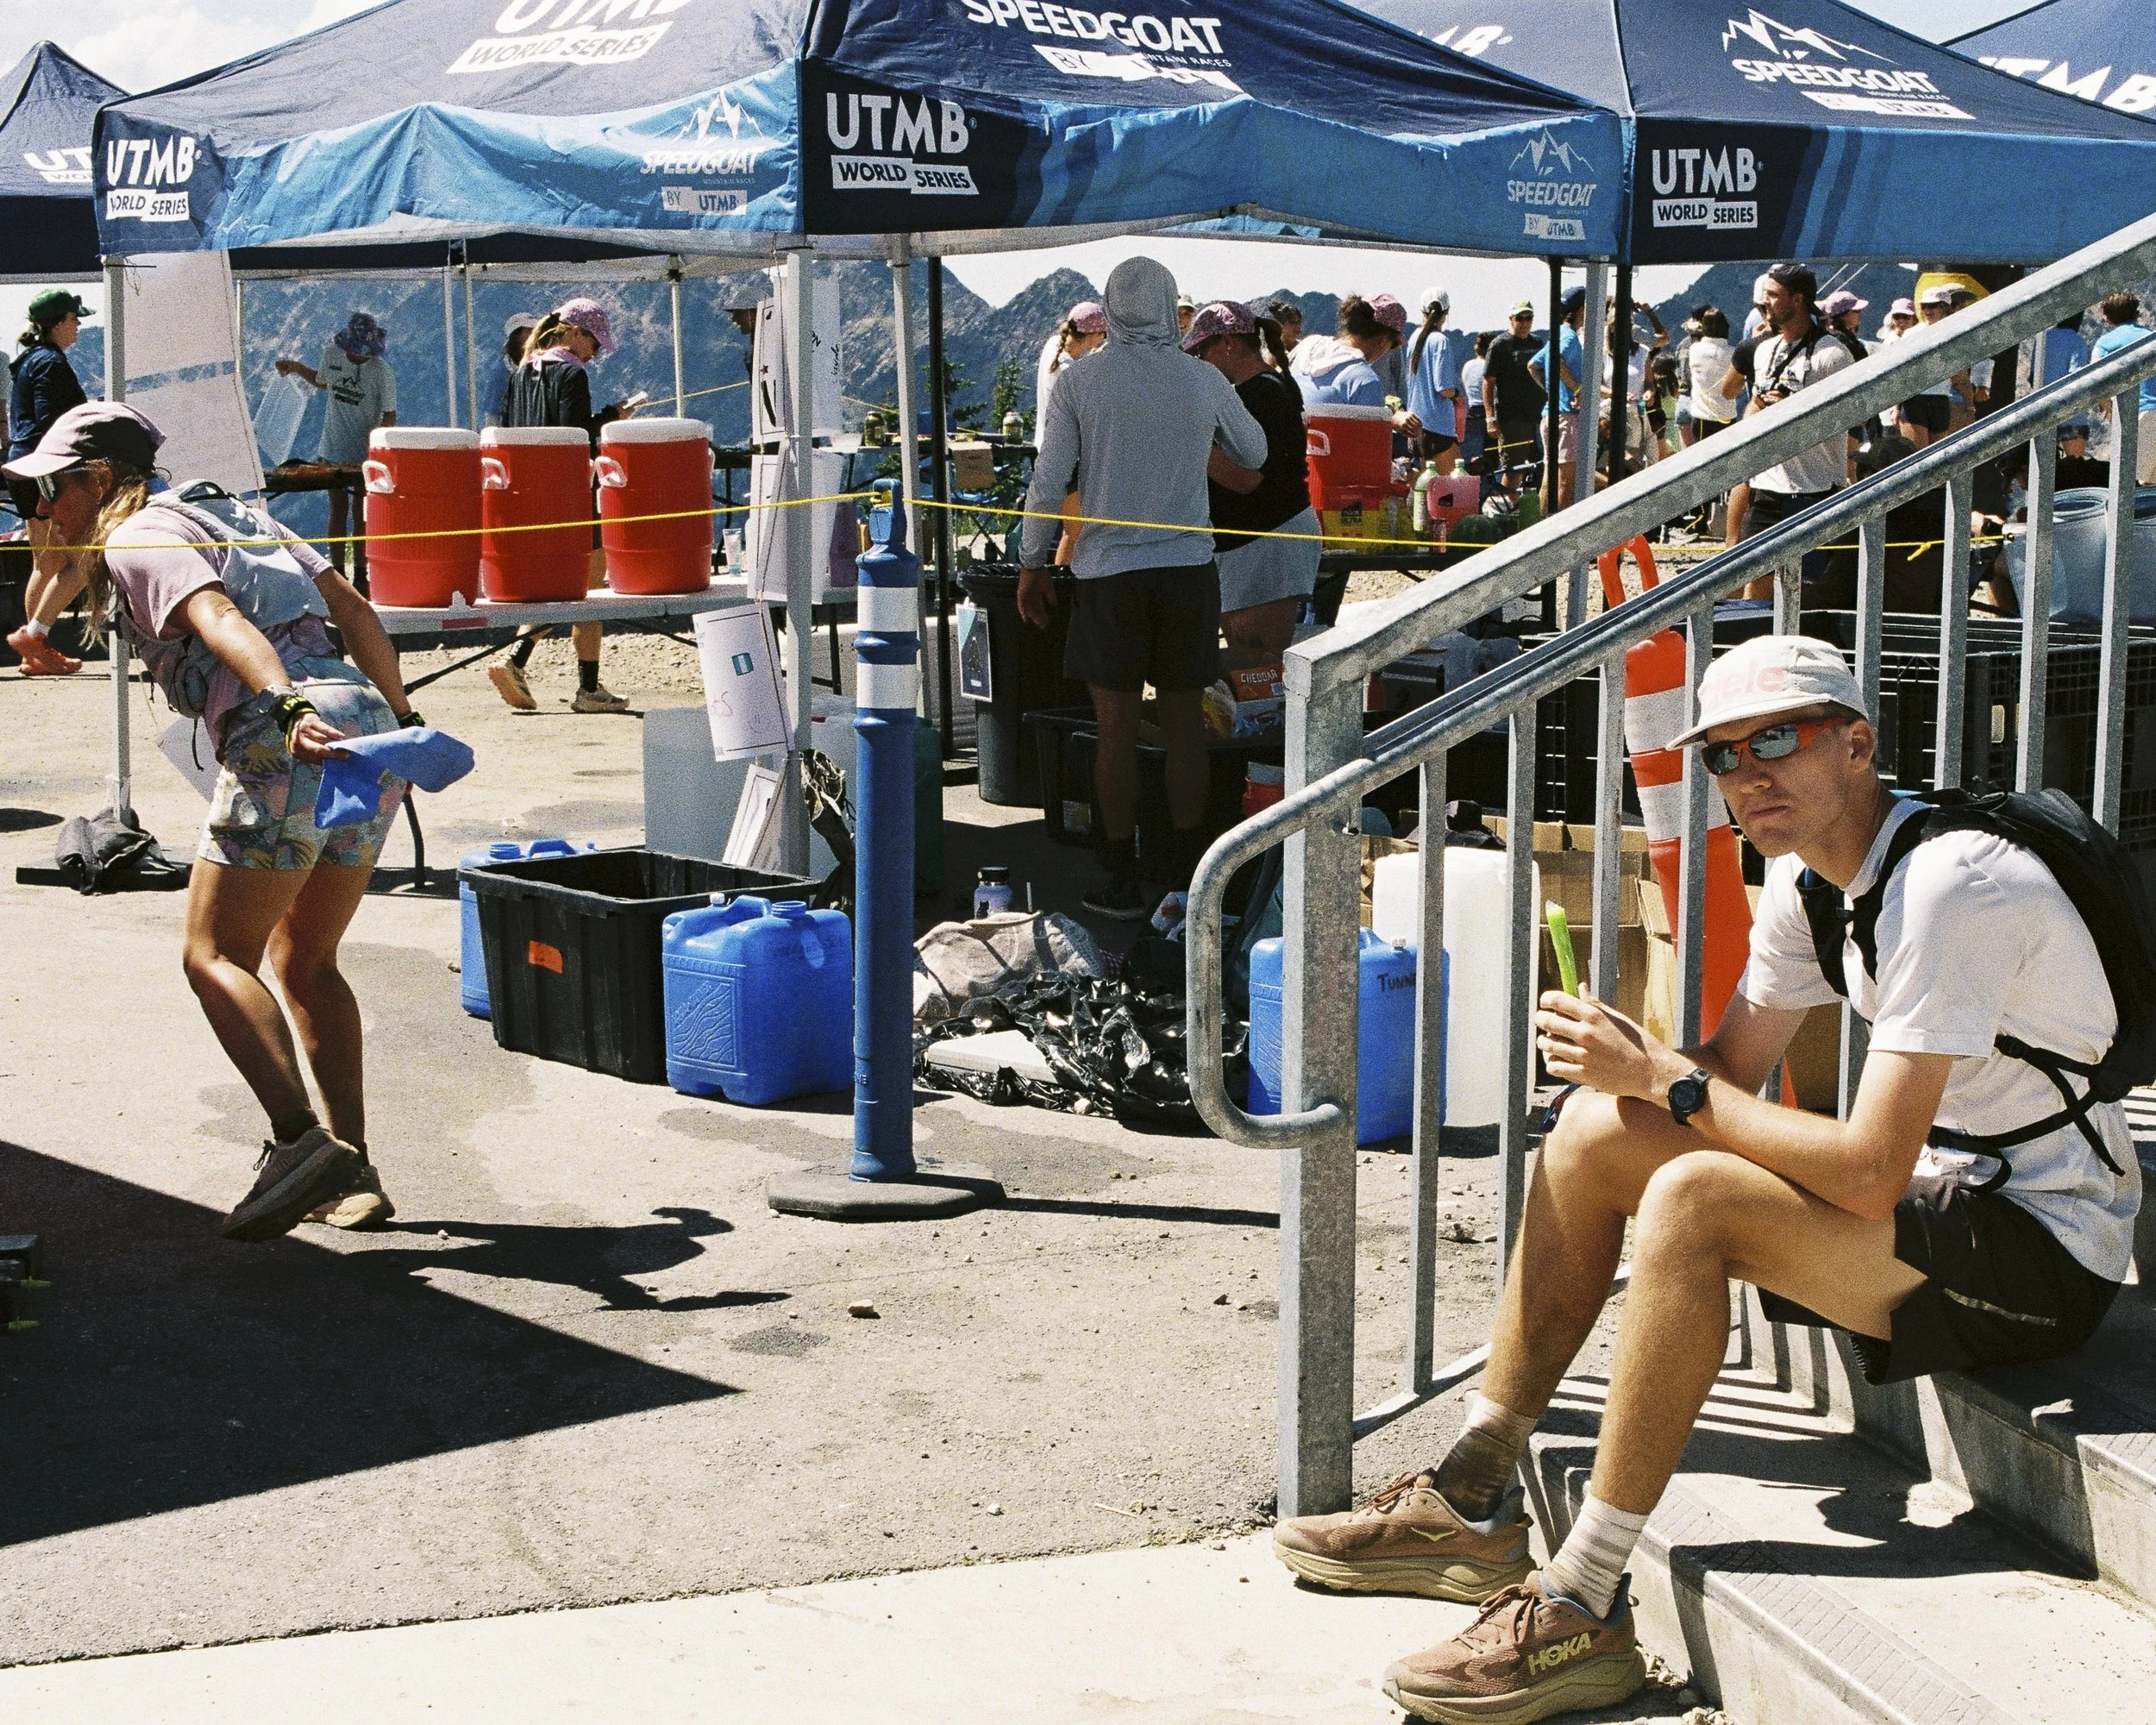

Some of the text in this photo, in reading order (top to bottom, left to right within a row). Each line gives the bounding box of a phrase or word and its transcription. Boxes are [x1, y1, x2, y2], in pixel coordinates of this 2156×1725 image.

[960, 0, 1224, 54] SPEEDGOAT
[467, 32, 657, 65] WORLD SERIES
[1050, 52, 1091, 69] BY
[1190, 57, 1232, 67] RACES
[1732, 59, 1940, 93] SPEEDGOAT
[826, 92, 969, 155] UTMB
[107, 135, 195, 186] UTMB
[640, 147, 764, 174] SPEEDGOAT
[1652, 145, 1757, 195] UTMB
[837, 161, 971, 189] WORLD SERIES
[149, 198, 186, 216] SERIES
[666, 190, 737, 211] BY UTMB
[1507, 179, 1597, 207] SPEEDGOAT
[1528, 217, 1539, 231] BY
[1658, 204, 1754, 223] WORLD SERIES
[1240, 668, 1278, 683] CHEDDAR
[1527, 1632, 1592, 1676] HOKA
